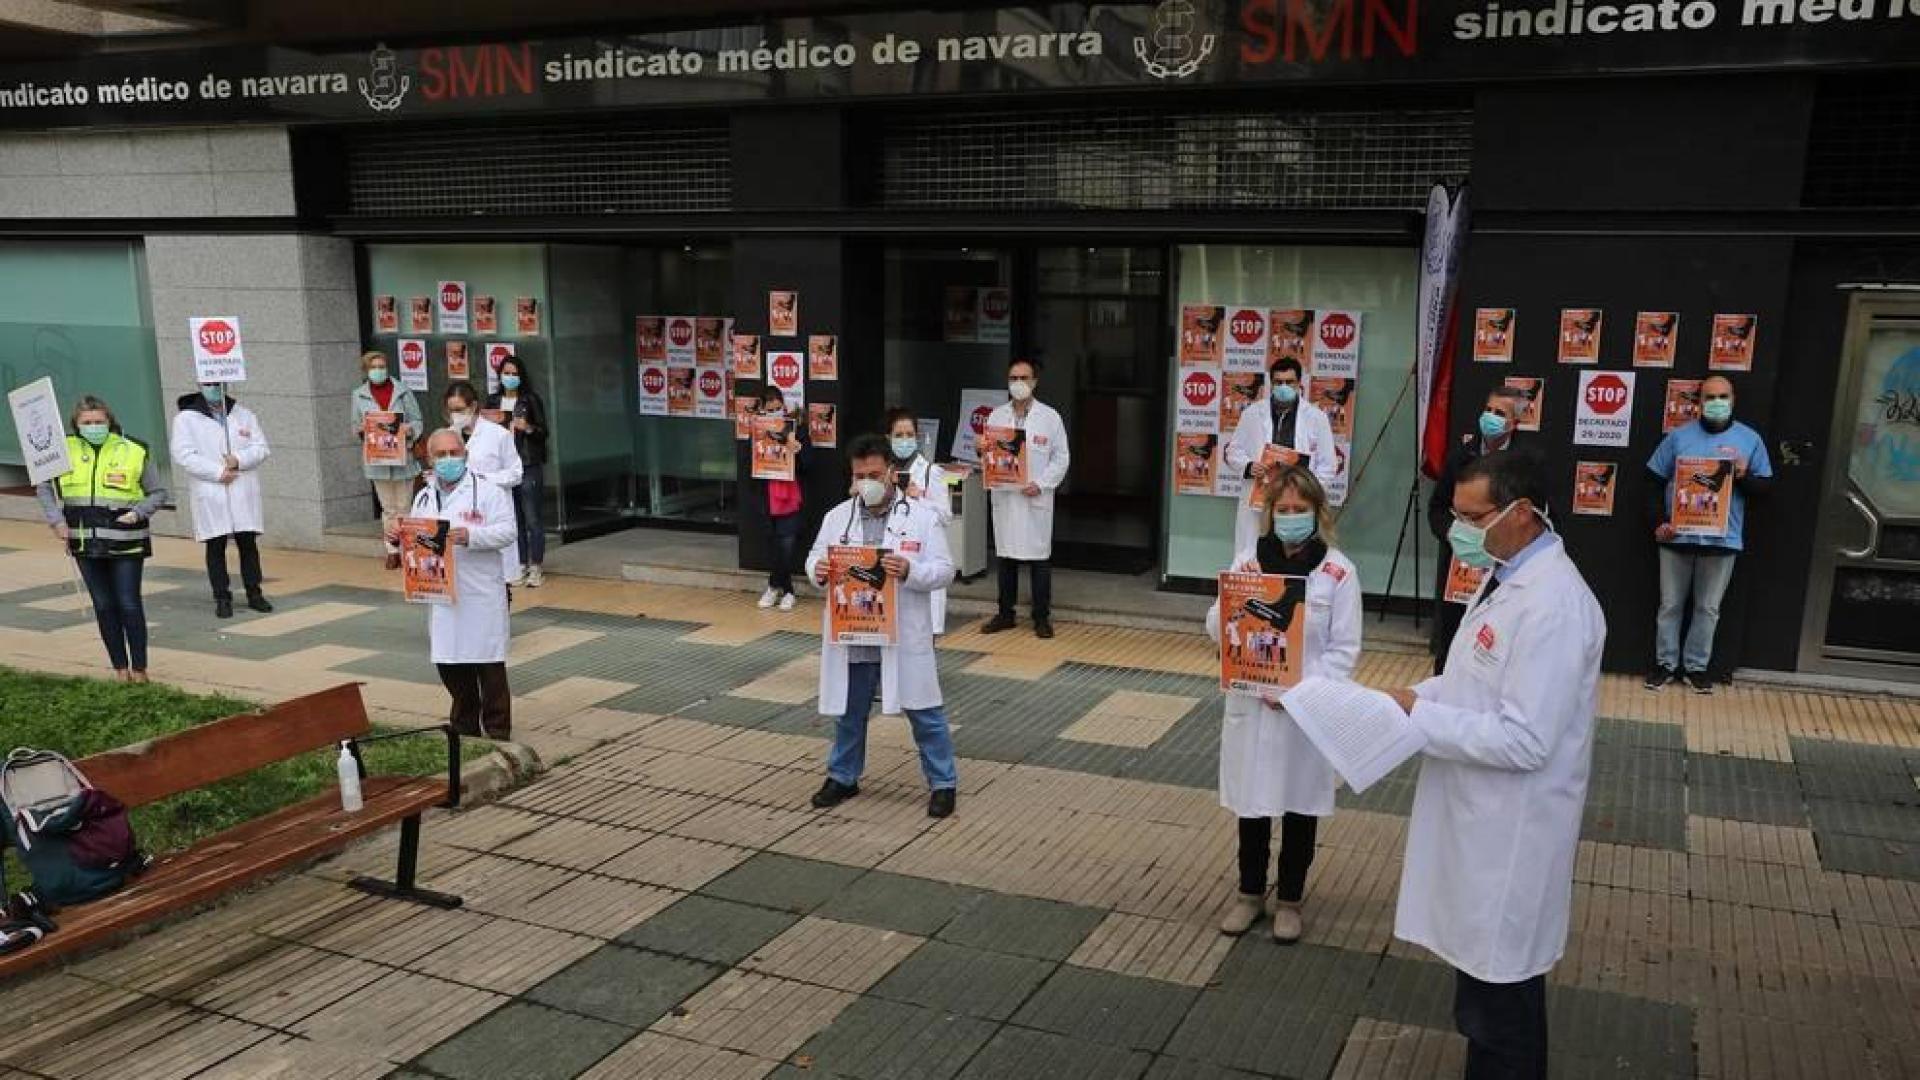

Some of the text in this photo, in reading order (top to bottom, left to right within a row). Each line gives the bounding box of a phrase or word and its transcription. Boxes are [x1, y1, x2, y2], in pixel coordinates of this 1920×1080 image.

[1452, 0, 1716, 40] sindicato
[1240, 0, 1418, 64] SMN
[545, 30, 1102, 82] sindicato médico de navarra
[419, 43, 534, 99] SMN
[98, 76, 190, 103] médico
[200, 73, 232, 99] de
[242, 73, 348, 97] navarra
[1232, 320, 1264, 335] STOP
[1322, 324, 1354, 339] STOP
[201, 331, 233, 344] STOP
[773, 364, 798, 378] STOP
[1184, 382, 1215, 397] STOP
[1588, 387, 1626, 403] STOP
